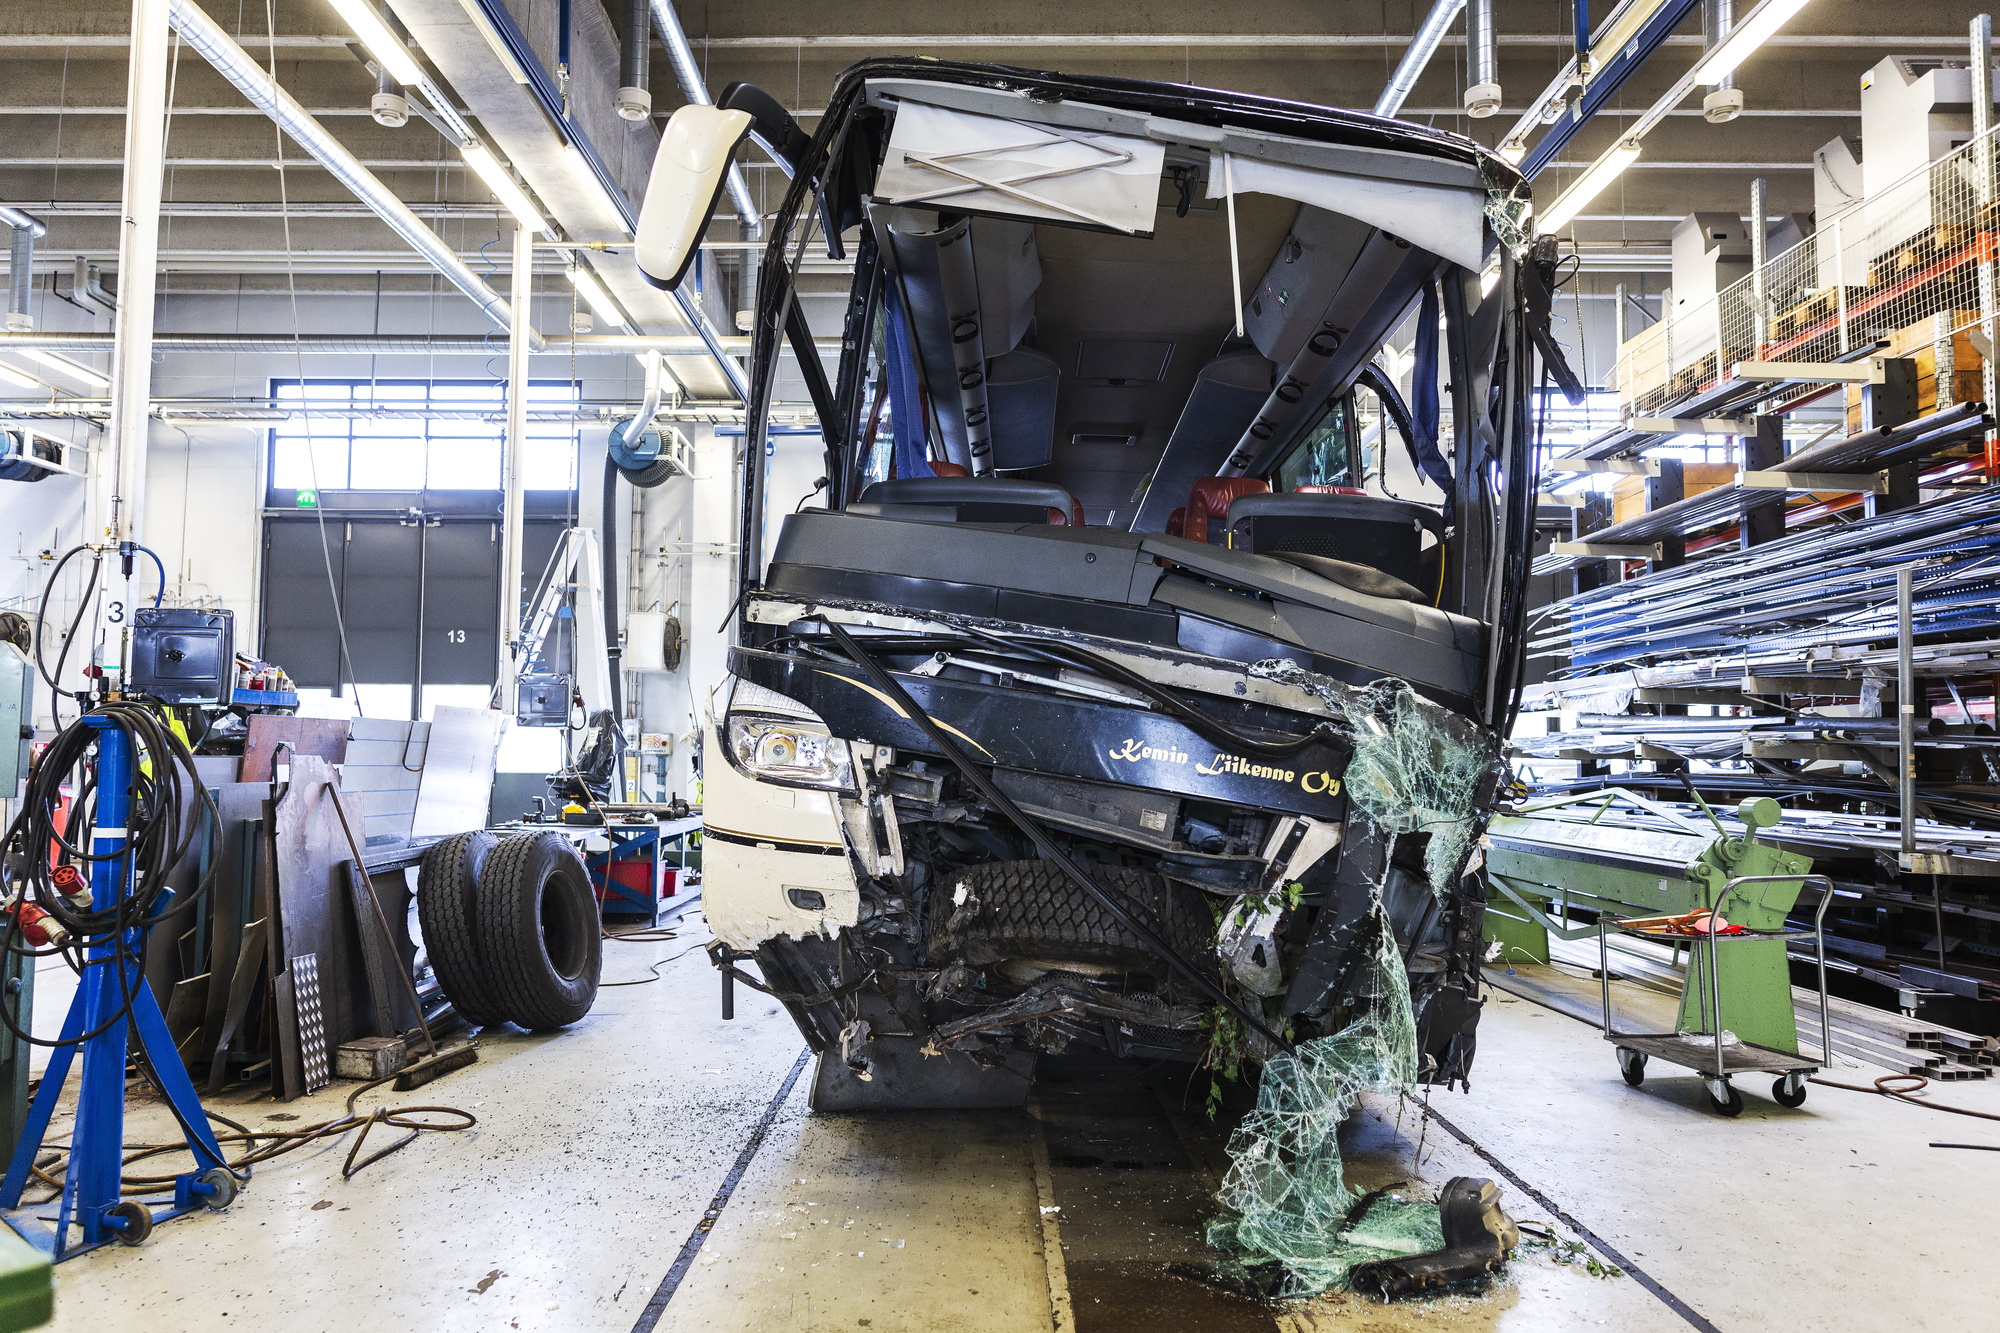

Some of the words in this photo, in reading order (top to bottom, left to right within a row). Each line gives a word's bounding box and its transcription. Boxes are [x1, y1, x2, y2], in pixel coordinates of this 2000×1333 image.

[108, 601, 124, 623] 3
[447, 629, 466, 644] 13
[1108, 738, 1188, 764] Kemin
[1195, 753, 1295, 783] Liikenne
[1300, 771, 1341, 797] Oy
[628, 781, 634, 791] 2
